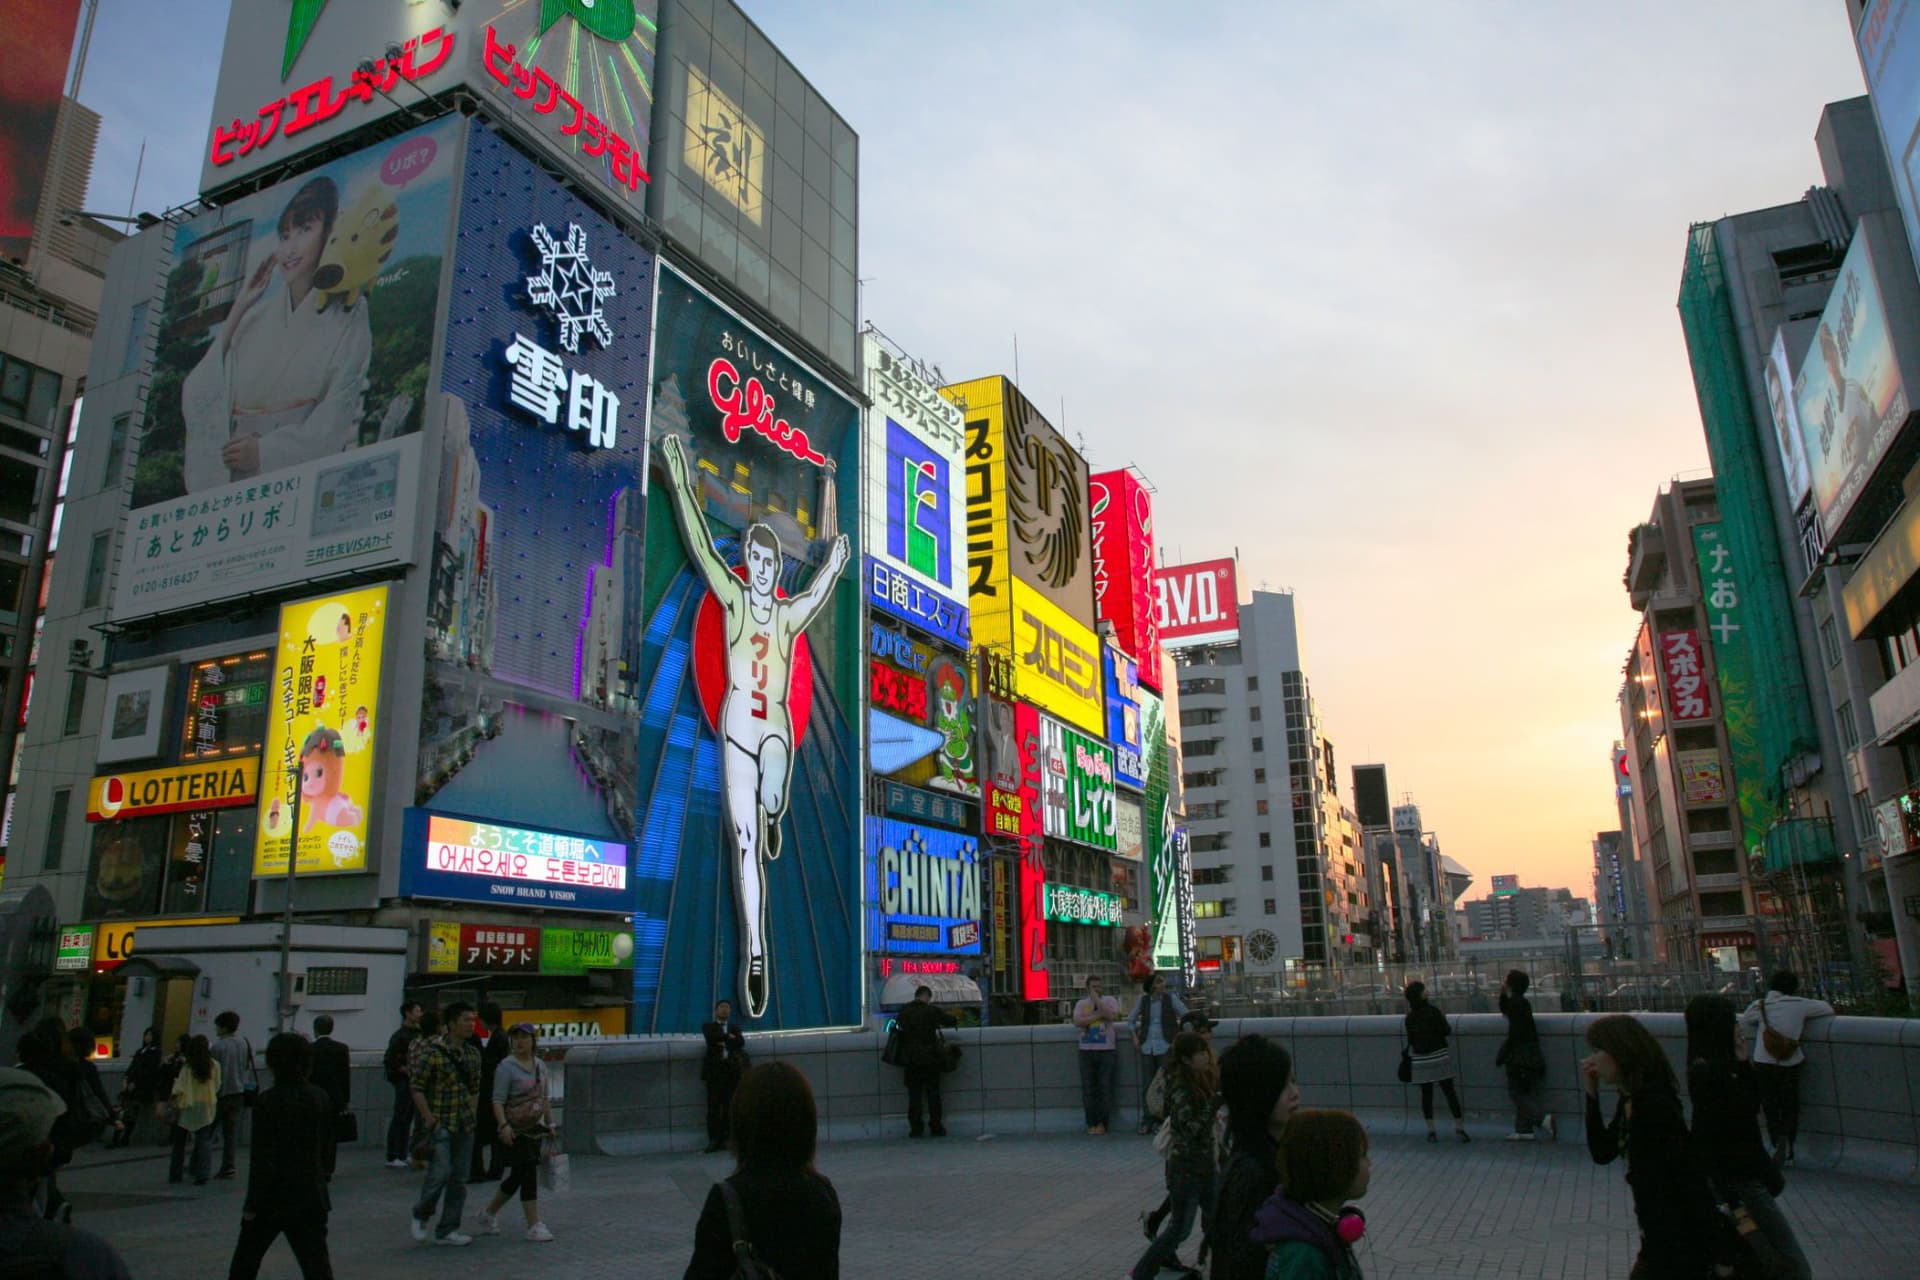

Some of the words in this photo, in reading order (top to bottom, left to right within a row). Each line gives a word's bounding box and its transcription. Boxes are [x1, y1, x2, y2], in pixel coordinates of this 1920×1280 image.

[210, 25, 455, 166] ピップエレキバン
[483, 25, 652, 192] ピップフジモト
[505, 335, 622, 451] 雪印
[721, 331, 817, 409] おいしさと健康
[706, 357, 826, 468] Glico
[879, 379, 962, 454] エステムコート
[964, 417, 998, 600] プロミス
[872, 562, 972, 642] 日商エステム
[1091, 520, 1109, 620] アイスター
[1139, 537, 1156, 678] アイスター
[295, 635, 317, 717] 大阪限定
[750, 631, 770, 721] グリコ
[1022, 610, 1102, 709] プロミス
[1665, 631, 1708, 719] スポタカ
[130, 767, 247, 807] LOTTERIA
[1075, 744, 1111, 784] ほのぼの
[469, 826, 600, 861] ようこそ道頓堀へ
[1073, 776, 1118, 837] レイク
[438, 844, 528, 878] 어서오세요
[546, 857, 621, 890] 도톤보리에
[490, 884, 515, 897] SNOW
[516, 886, 546, 899] BRAND
[549, 889, 577, 902] VISION
[883, 846, 981, 921] CHINTAI
[467, 946, 533, 966] アドアド
